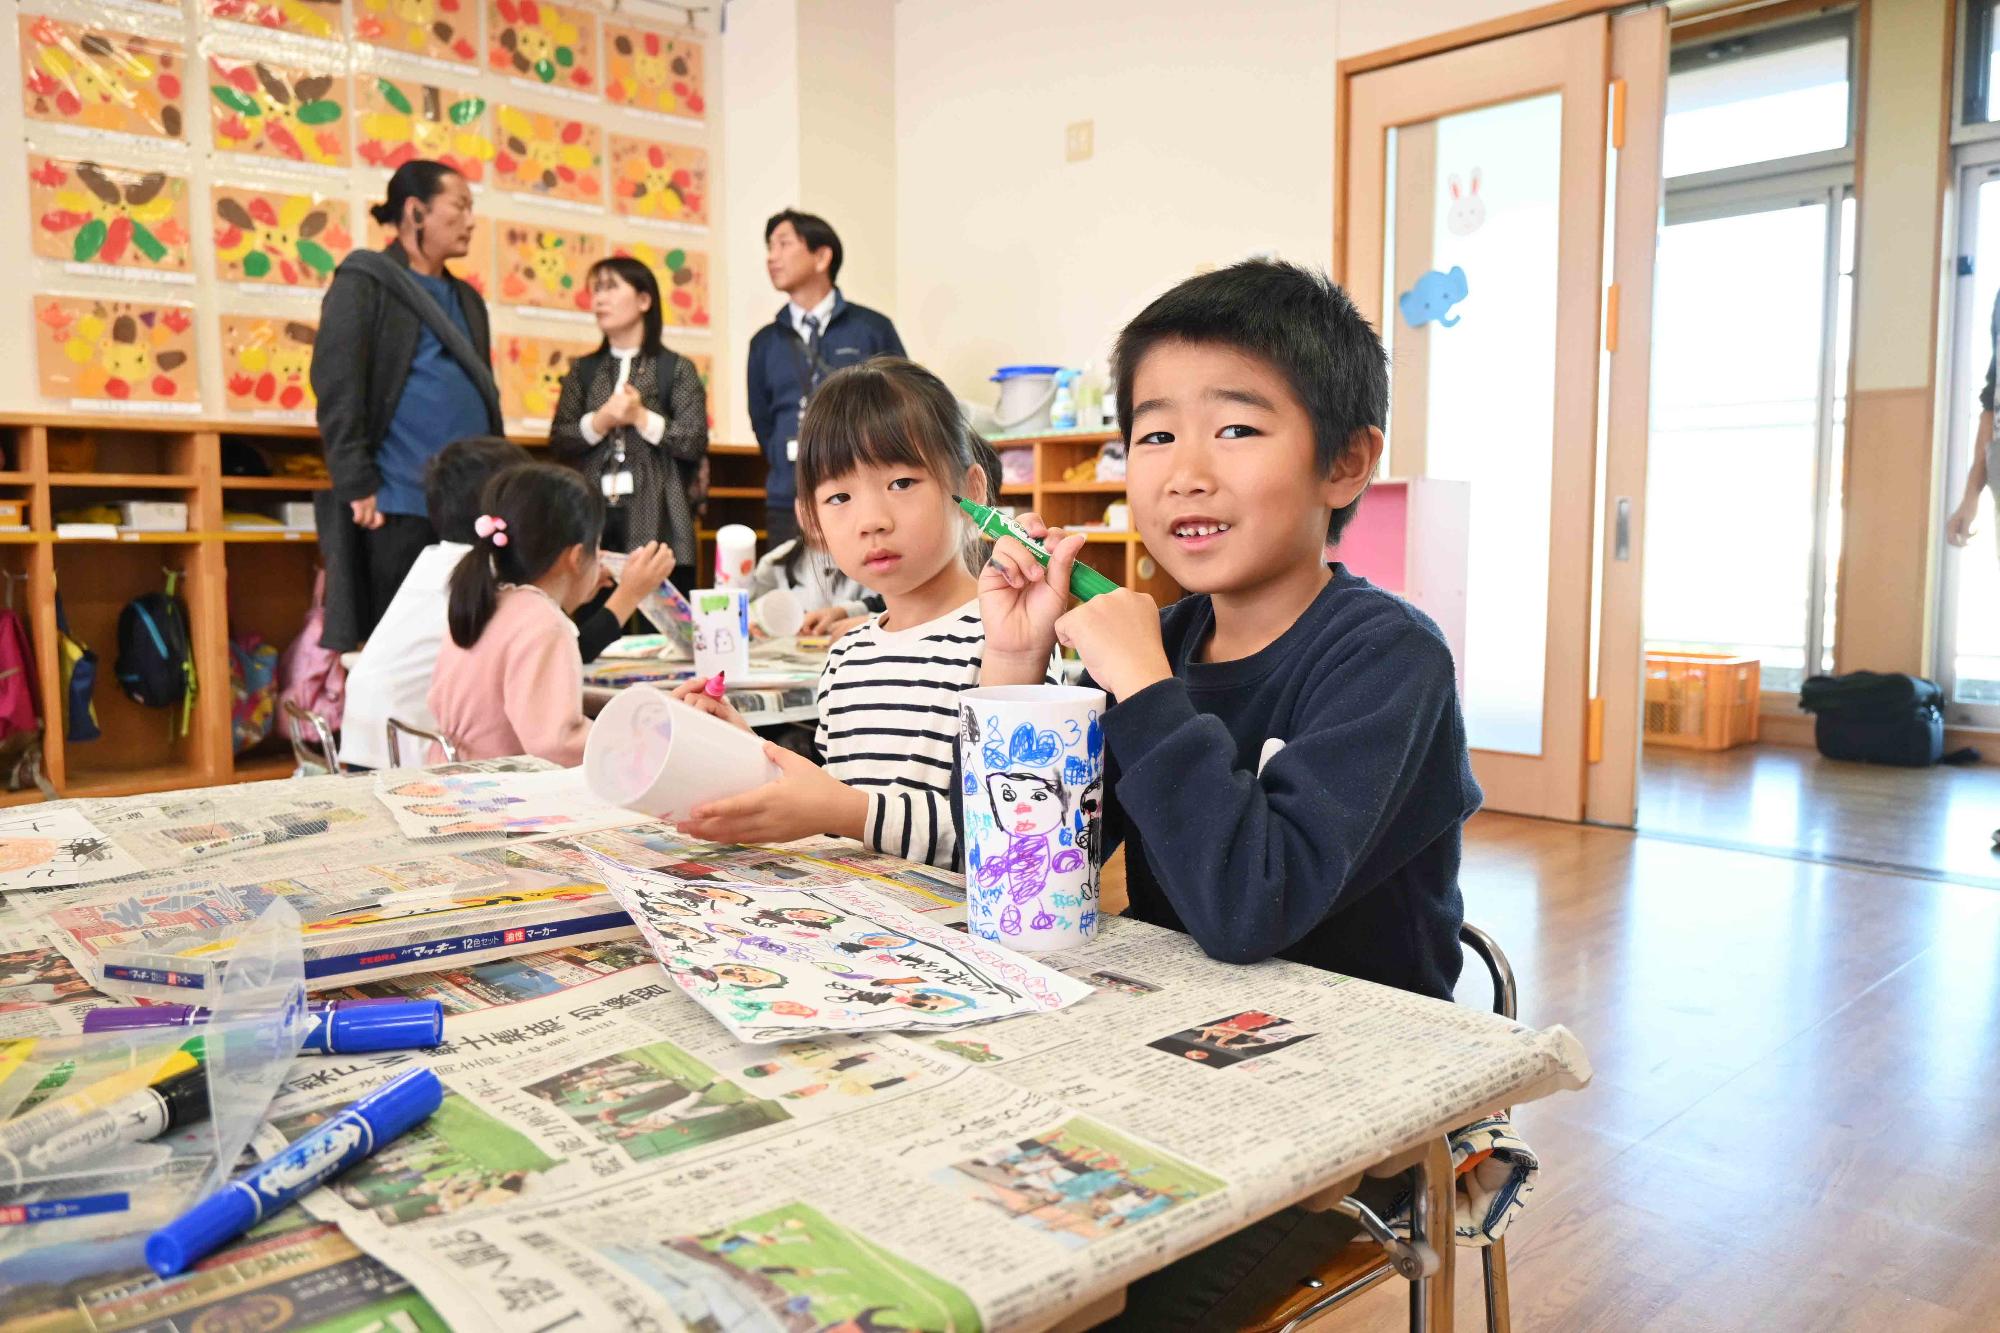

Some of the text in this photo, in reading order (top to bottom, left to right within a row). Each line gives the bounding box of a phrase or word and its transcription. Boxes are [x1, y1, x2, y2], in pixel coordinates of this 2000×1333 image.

[359, 953, 397, 966] ZEBRA
[462, 935, 499, 950] 12色セット
[504, 929, 526, 944] 油性
[526, 926, 558, 938] マーカー
